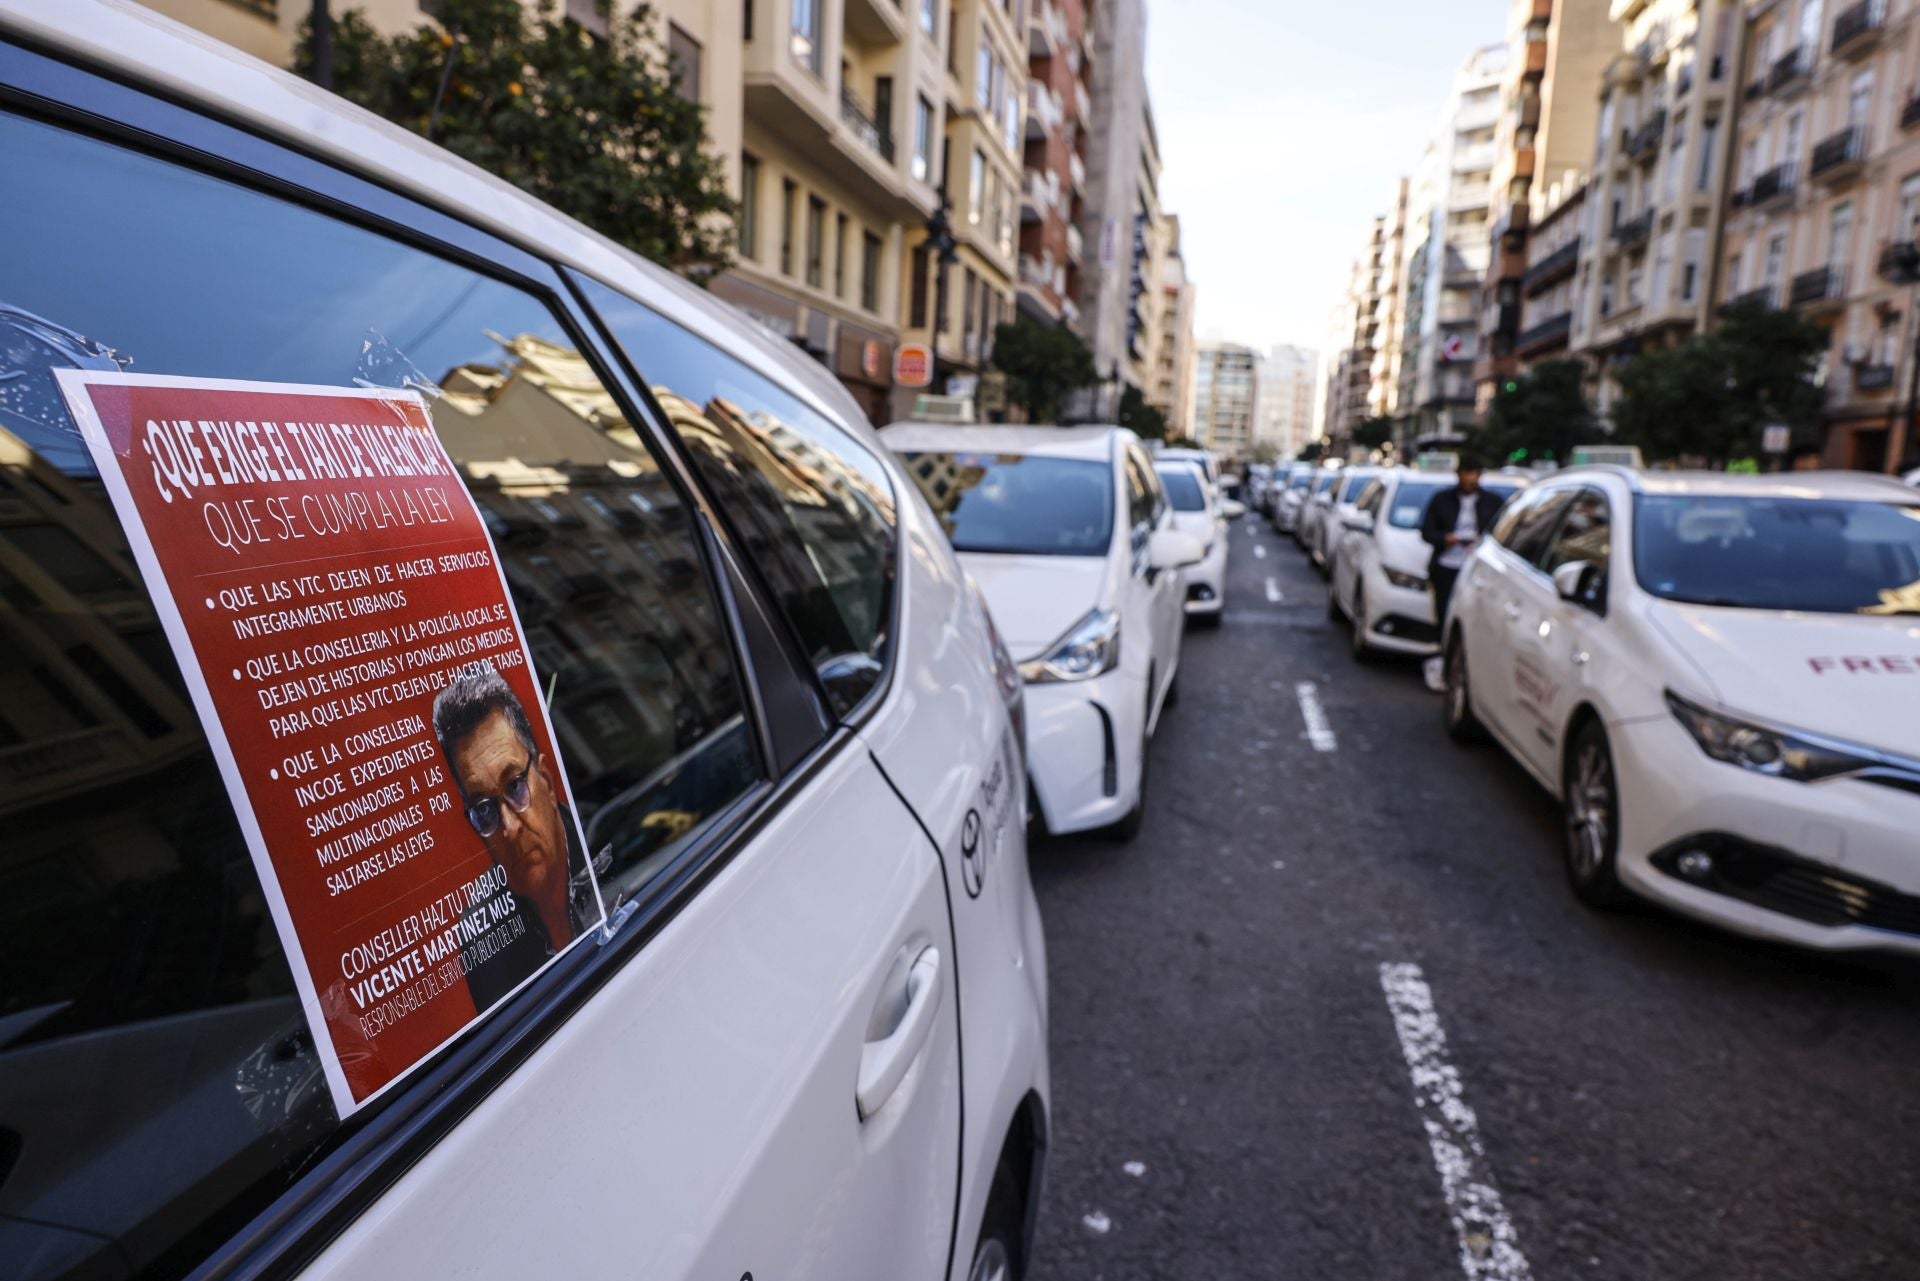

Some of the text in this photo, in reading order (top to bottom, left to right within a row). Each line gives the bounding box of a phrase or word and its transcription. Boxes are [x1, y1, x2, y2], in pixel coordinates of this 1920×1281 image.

[142, 420, 450, 503] ¿QUE EXIGE EL TAXI DE VALENCIA?
[203, 487, 455, 554] QUE SE CUMPLA LA LEY
[219, 551, 490, 612] QUE LAS VTC DEJEN DE HACER SERVICIOS
[232, 590, 407, 639] INTEGRAMENTE URBANOS
[246, 603, 507, 681] QUE LA CONSELLERIA Y LA POLICÍA LOCAL SE
[258, 627, 514, 709] DEJEN DE HISTORIAS Y PONGAN LOS MEDIOS
[269, 649, 523, 739] PARA QUE LAS VTC DEJEN DE HACER DE TAXIS
[283, 714, 427, 779] QUE LA CONSELLERIA
[295, 740, 435, 808] INCOE EXPEDIENTES
[306, 765, 443, 837] SANCIONADORES A LAS
[316, 792, 452, 868] MULTINACIONALES POR
[326, 829, 434, 897] SALTARSE LAS LEYES
[341, 864, 508, 979] CONSELLER HAZ TU TRABAJO
[350, 891, 516, 1009] VICENTE MARTINEZ MUS
[359, 914, 526, 1040] RESPONSABLE DEL SERVICIO PÚBLICO DEL TAXI
